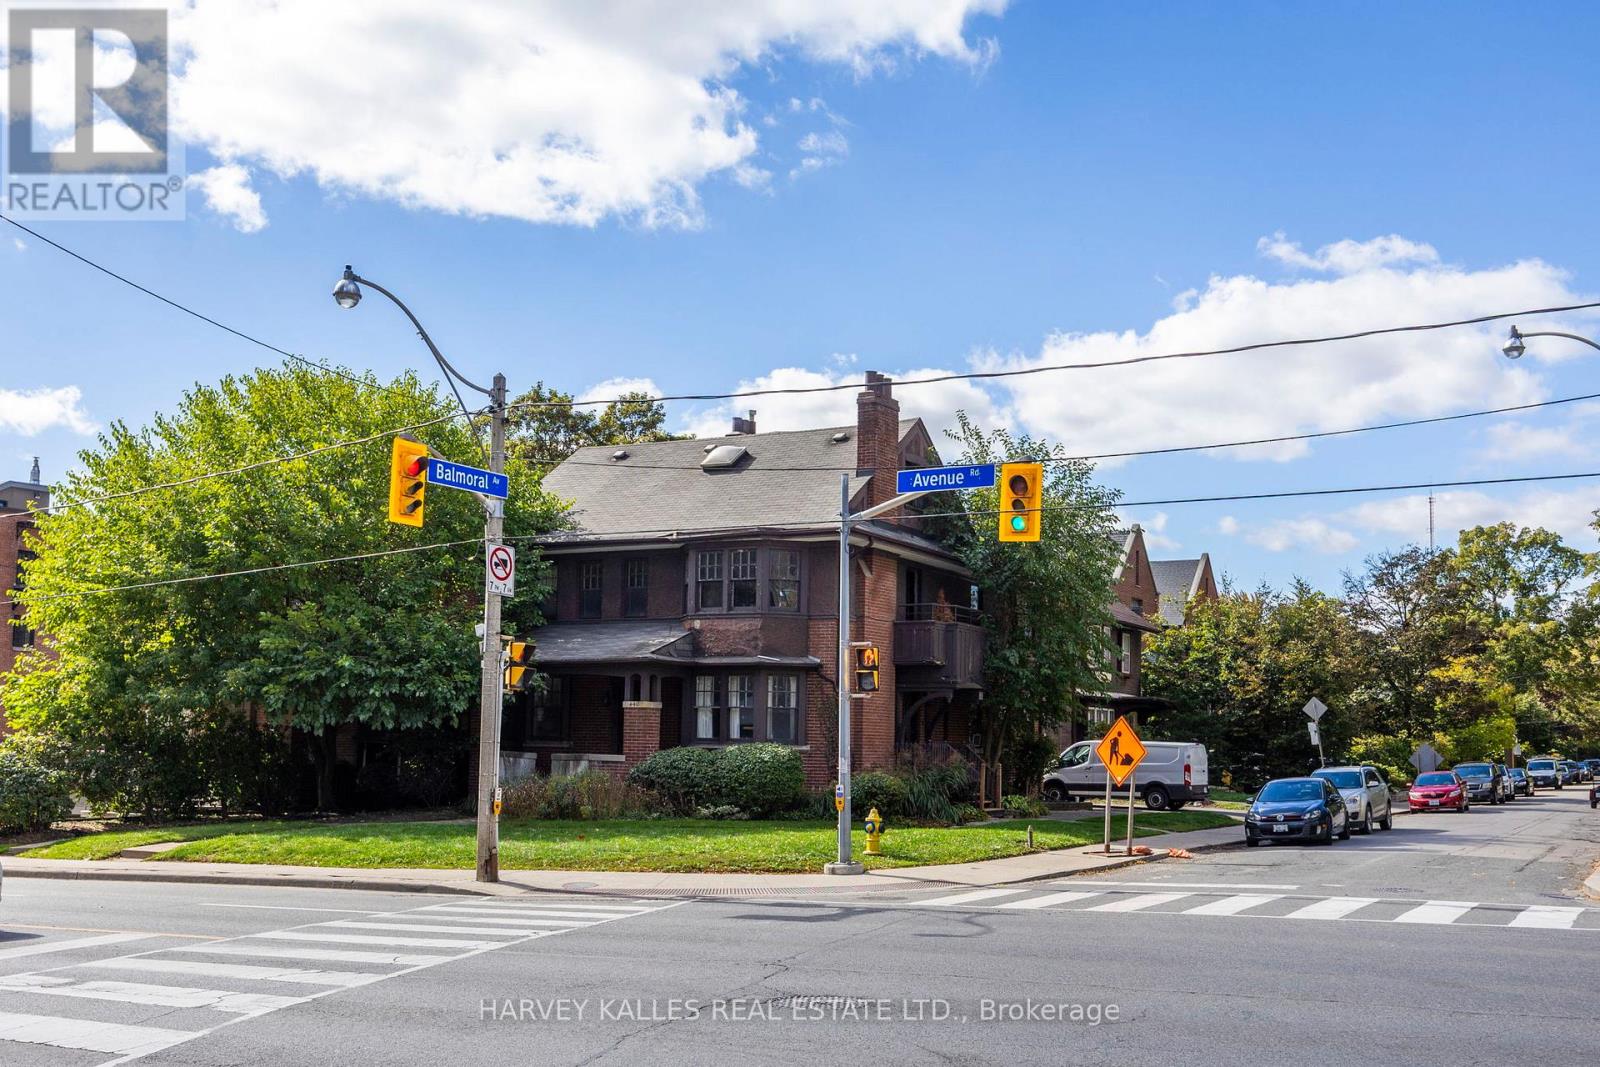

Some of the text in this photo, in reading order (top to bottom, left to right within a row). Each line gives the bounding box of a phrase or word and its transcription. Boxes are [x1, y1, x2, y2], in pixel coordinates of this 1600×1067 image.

[436, 463, 489, 489] Balmoral
[912, 469, 979, 488] Avenue Rd
